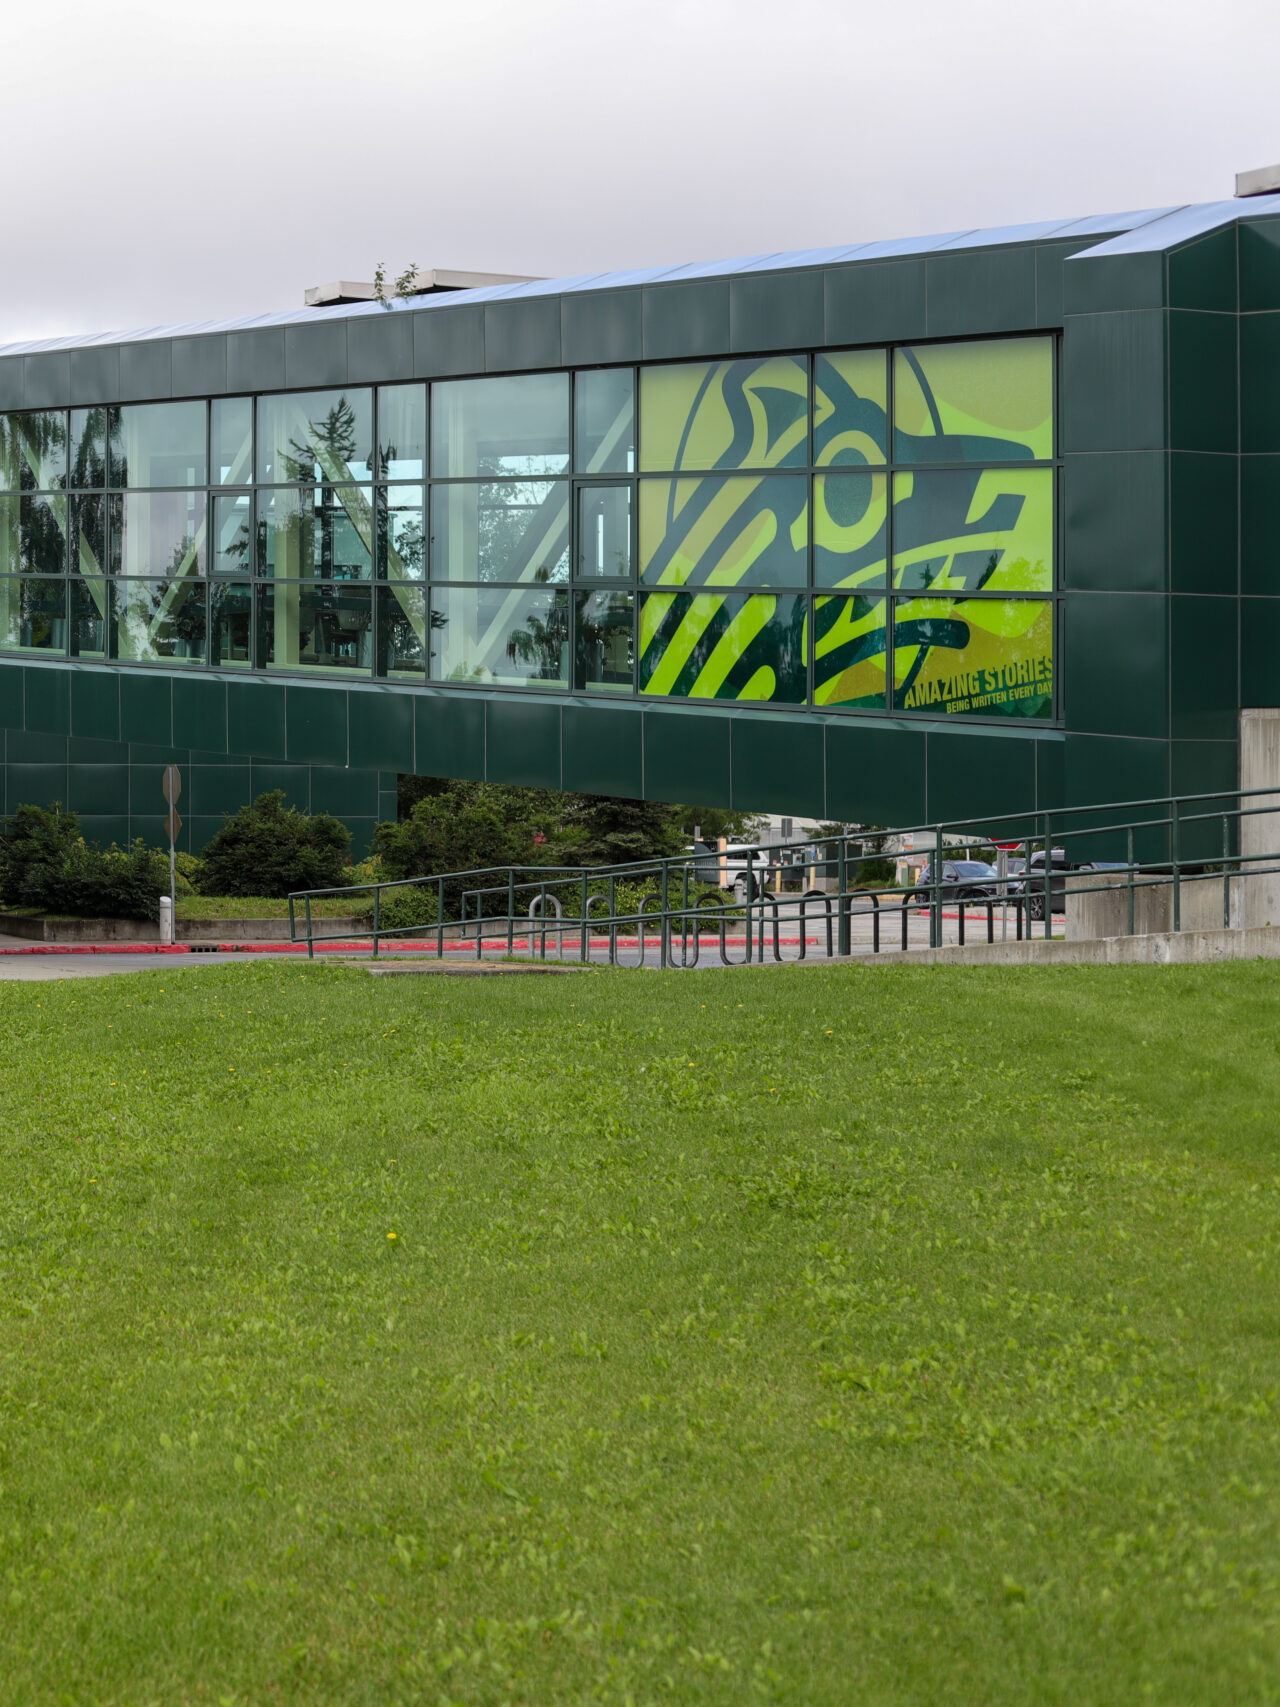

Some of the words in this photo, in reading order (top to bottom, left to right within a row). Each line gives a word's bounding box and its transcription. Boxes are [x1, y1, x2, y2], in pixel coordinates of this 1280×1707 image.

[904, 671, 980, 709] AMAZING
[984, 656, 1053, 692] STORIES
[946, 700, 970, 714] BEING
[971, 691, 1007, 709] WRITTEN
[1009, 684, 1036, 701] EVERY
[1037, 680, 1053, 695] DAY
